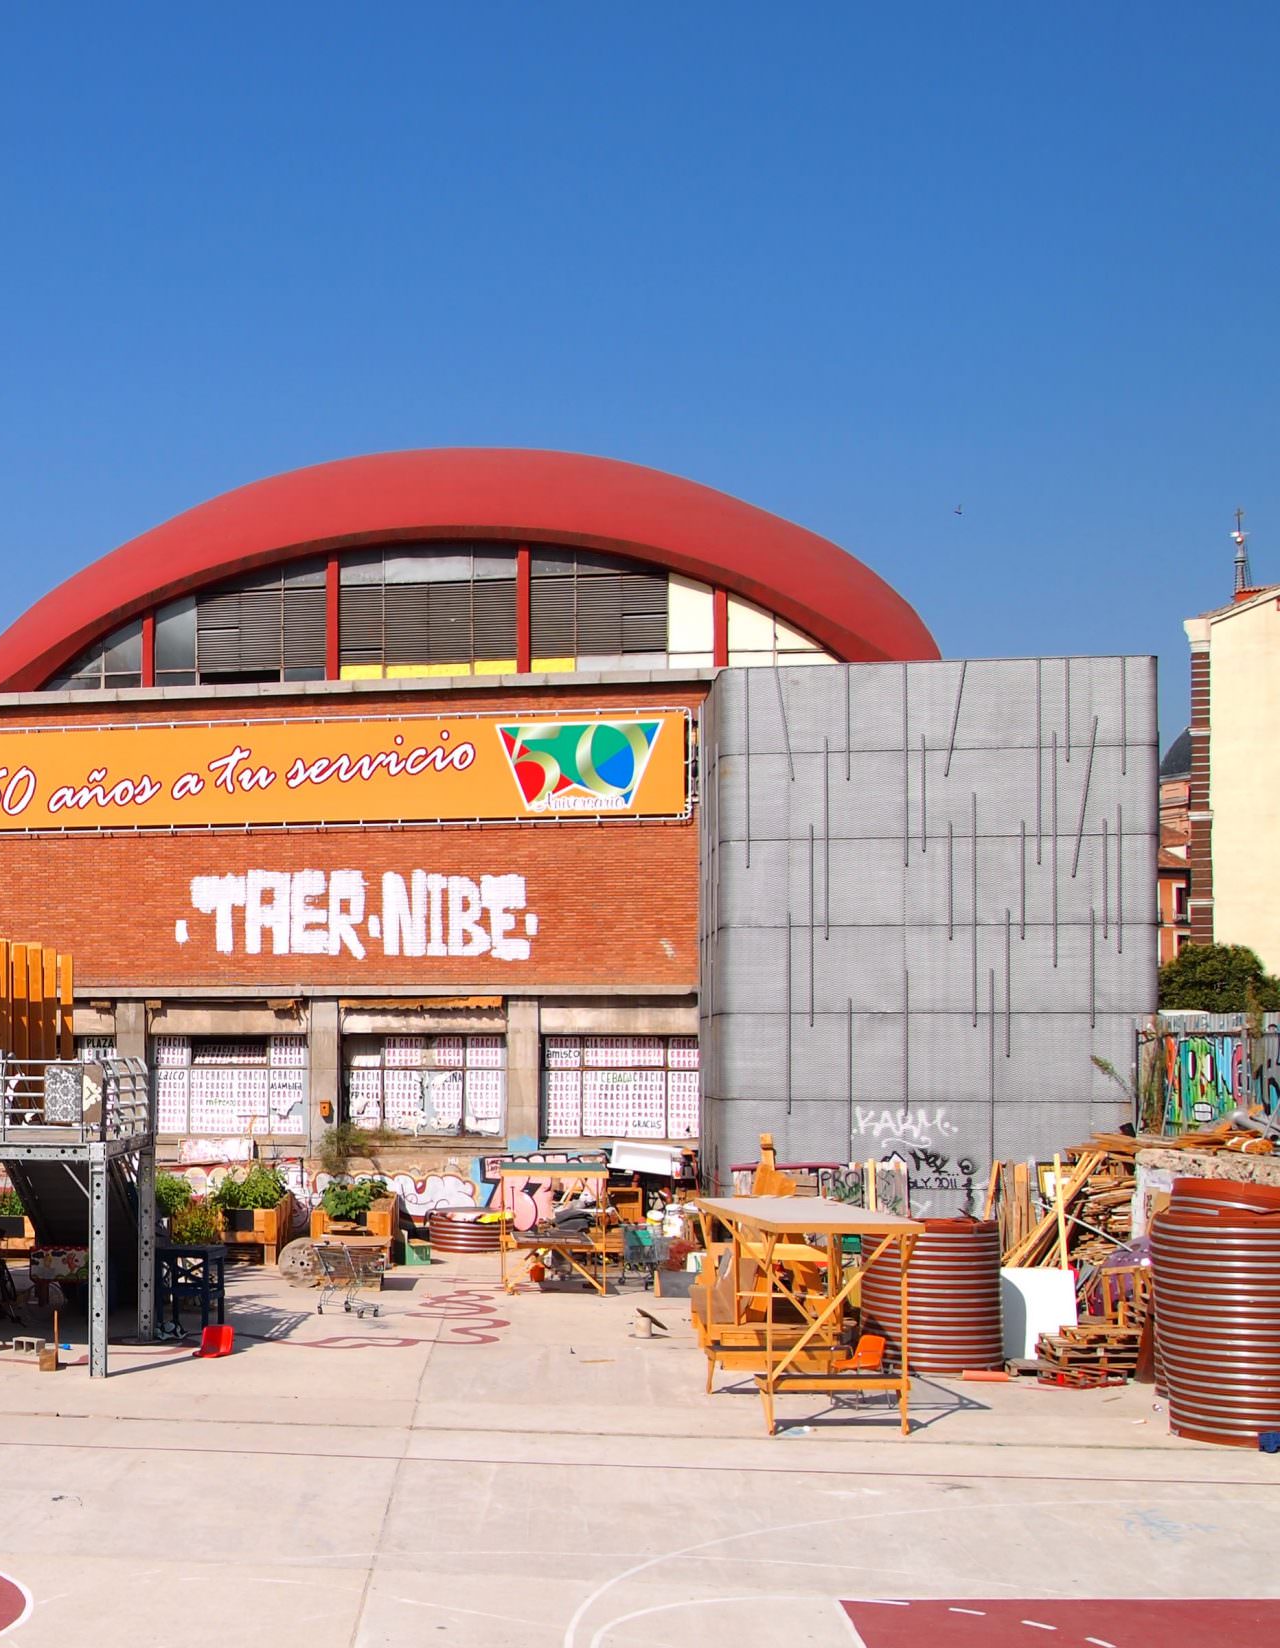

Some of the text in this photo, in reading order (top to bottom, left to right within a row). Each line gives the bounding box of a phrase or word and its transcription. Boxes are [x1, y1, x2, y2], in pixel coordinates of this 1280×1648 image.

[47, 767, 161, 813] años
[171, 773, 204, 800] a
[208, 746, 276, 793] tu
[286, 730, 475, 789] servicio
[87, 1039, 114, 1048] PLAZA
[934, 1177, 957, 1189] 2011
